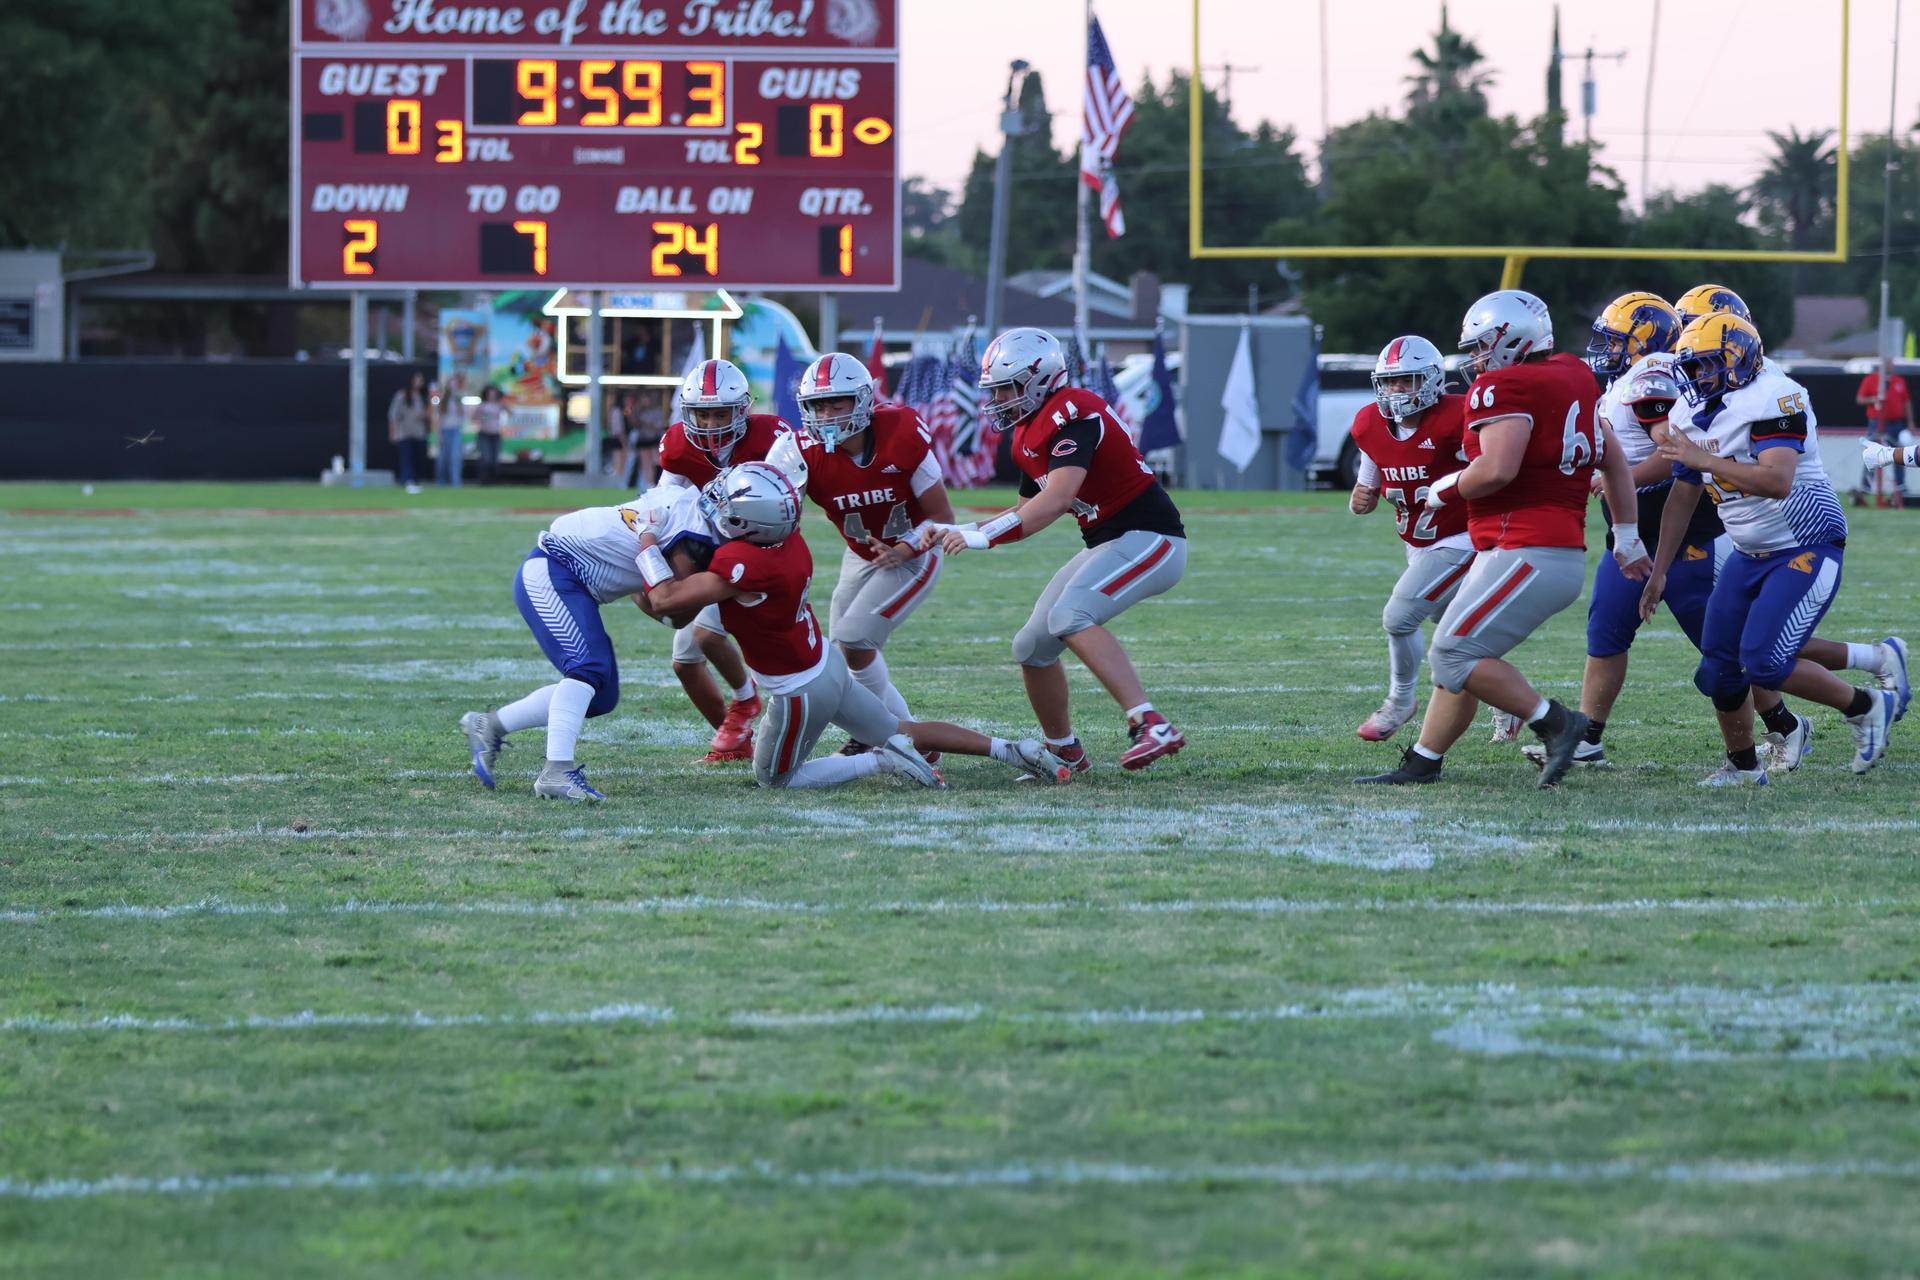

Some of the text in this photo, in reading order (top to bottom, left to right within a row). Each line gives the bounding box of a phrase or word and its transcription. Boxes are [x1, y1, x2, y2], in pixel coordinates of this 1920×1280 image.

[383, 0, 815, 45] Home of the Tribe!
[319, 64, 446, 95] GUEST
[759, 68, 861, 99] CUHS
[386, 99, 422, 155] 0
[435, 119, 463, 163] 3
[809, 103, 844, 158] 0
[466, 138, 514, 162] TOL
[685, 140, 732, 164] TOL
[734, 122, 763, 165] 2
[312, 184, 409, 212] DOWN
[466, 185, 560, 212] TO GO
[616, 186, 753, 214] BALL ON
[799, 188, 872, 216] QTR.
[343, 219, 378, 275] 2
[513, 220, 547, 275] 7
[651, 221, 719, 277] 24
[838, 223, 853, 276] 1
[1469, 384, 1496, 410] 66
[1381, 465, 1430, 482] TRIBE
[833, 487, 897, 511] TRIBE
